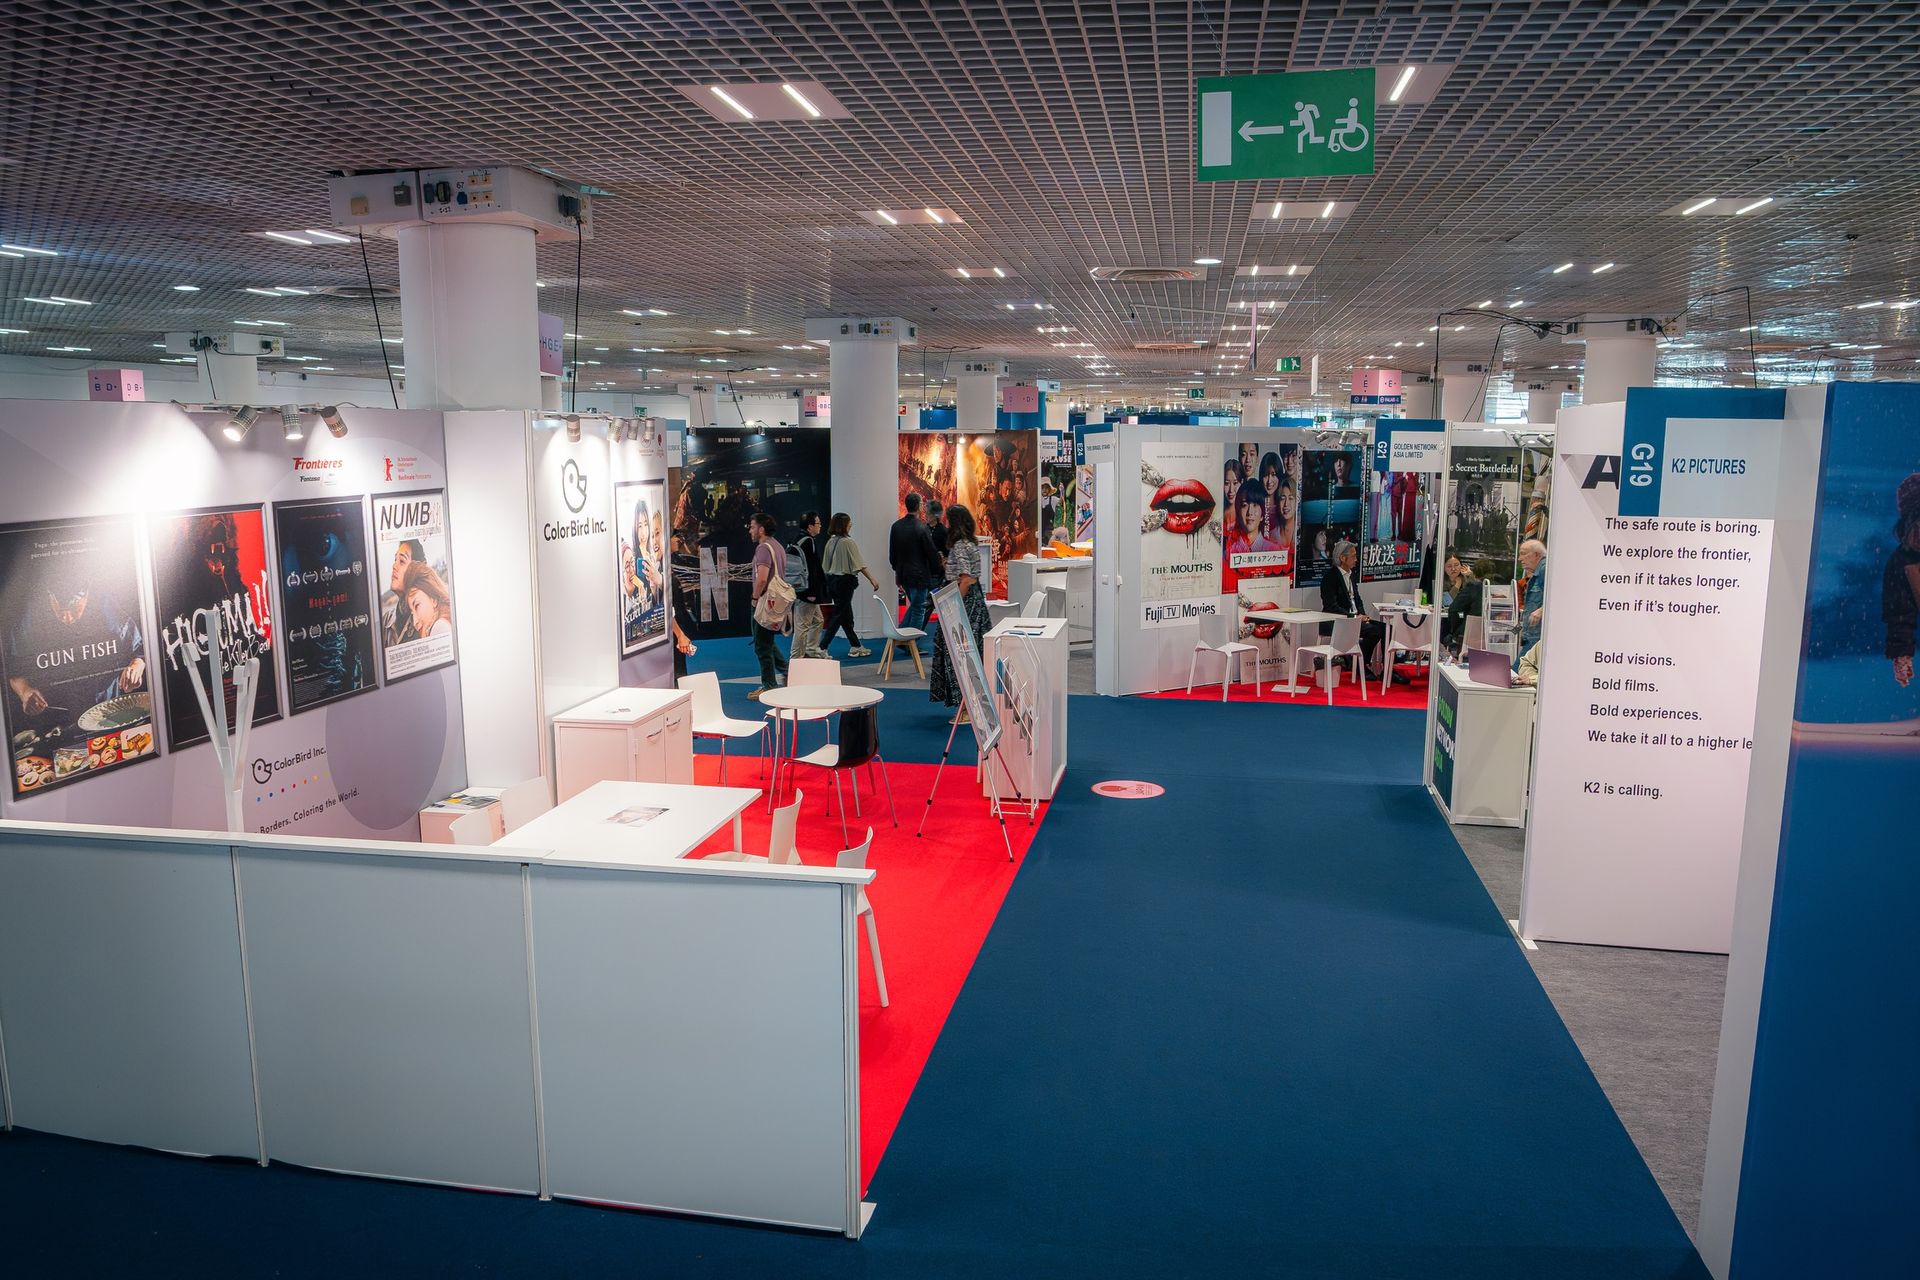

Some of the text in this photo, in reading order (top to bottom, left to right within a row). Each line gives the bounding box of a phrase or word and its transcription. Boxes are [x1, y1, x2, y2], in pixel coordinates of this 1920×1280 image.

[1377, 441, 1388, 458] G21
[1456, 463, 1477, 472] Secret
[1480, 464, 1518, 473] Battlefield
[1629, 443, 1655, 487] G19
[1672, 458, 1746, 474] K2 PICTURES
[380, 501, 430, 530] NUMB
[544, 517, 607, 542] ColorBird Inc.
[1605, 518, 1761, 536] The safe route is boring.
[1233, 554, 1285, 566] 口に関するアンケート
[1603, 544, 1752, 562] We explore the frontier,
[1150, 563, 1213, 574] THE MOUTHS
[1600, 572, 1740, 590] even if it takes longer.
[1146, 603, 1216, 624] Fuji TV Movies
[1599, 598, 1630, 611] Even
[1634, 599, 1643, 612] if
[1668, 601, 1720, 616] tougher.
[36, 640, 118, 669] GUN FISH
[1259, 657, 1286, 666] MOUTHS
[1594, 651, 1676, 666] Bold visions.
[1592, 678, 1659, 692] Bold films.
[1590, 704, 1702, 721] Bold experiences.
[1588, 730, 1607, 742] We
[1610, 732, 1637, 744] take
[1640, 732, 1648, 744] it
[1652, 734, 1666, 745] all
[1670, 734, 1683, 746] to
[1686, 738, 1694, 747] a
[1698, 736, 1739, 750] higher
[274, 746, 326, 771] ColorBird Inc.
[1584, 782, 1663, 800] K2 is calling.
[260, 788, 360, 834] Borders. Coloring the World.
